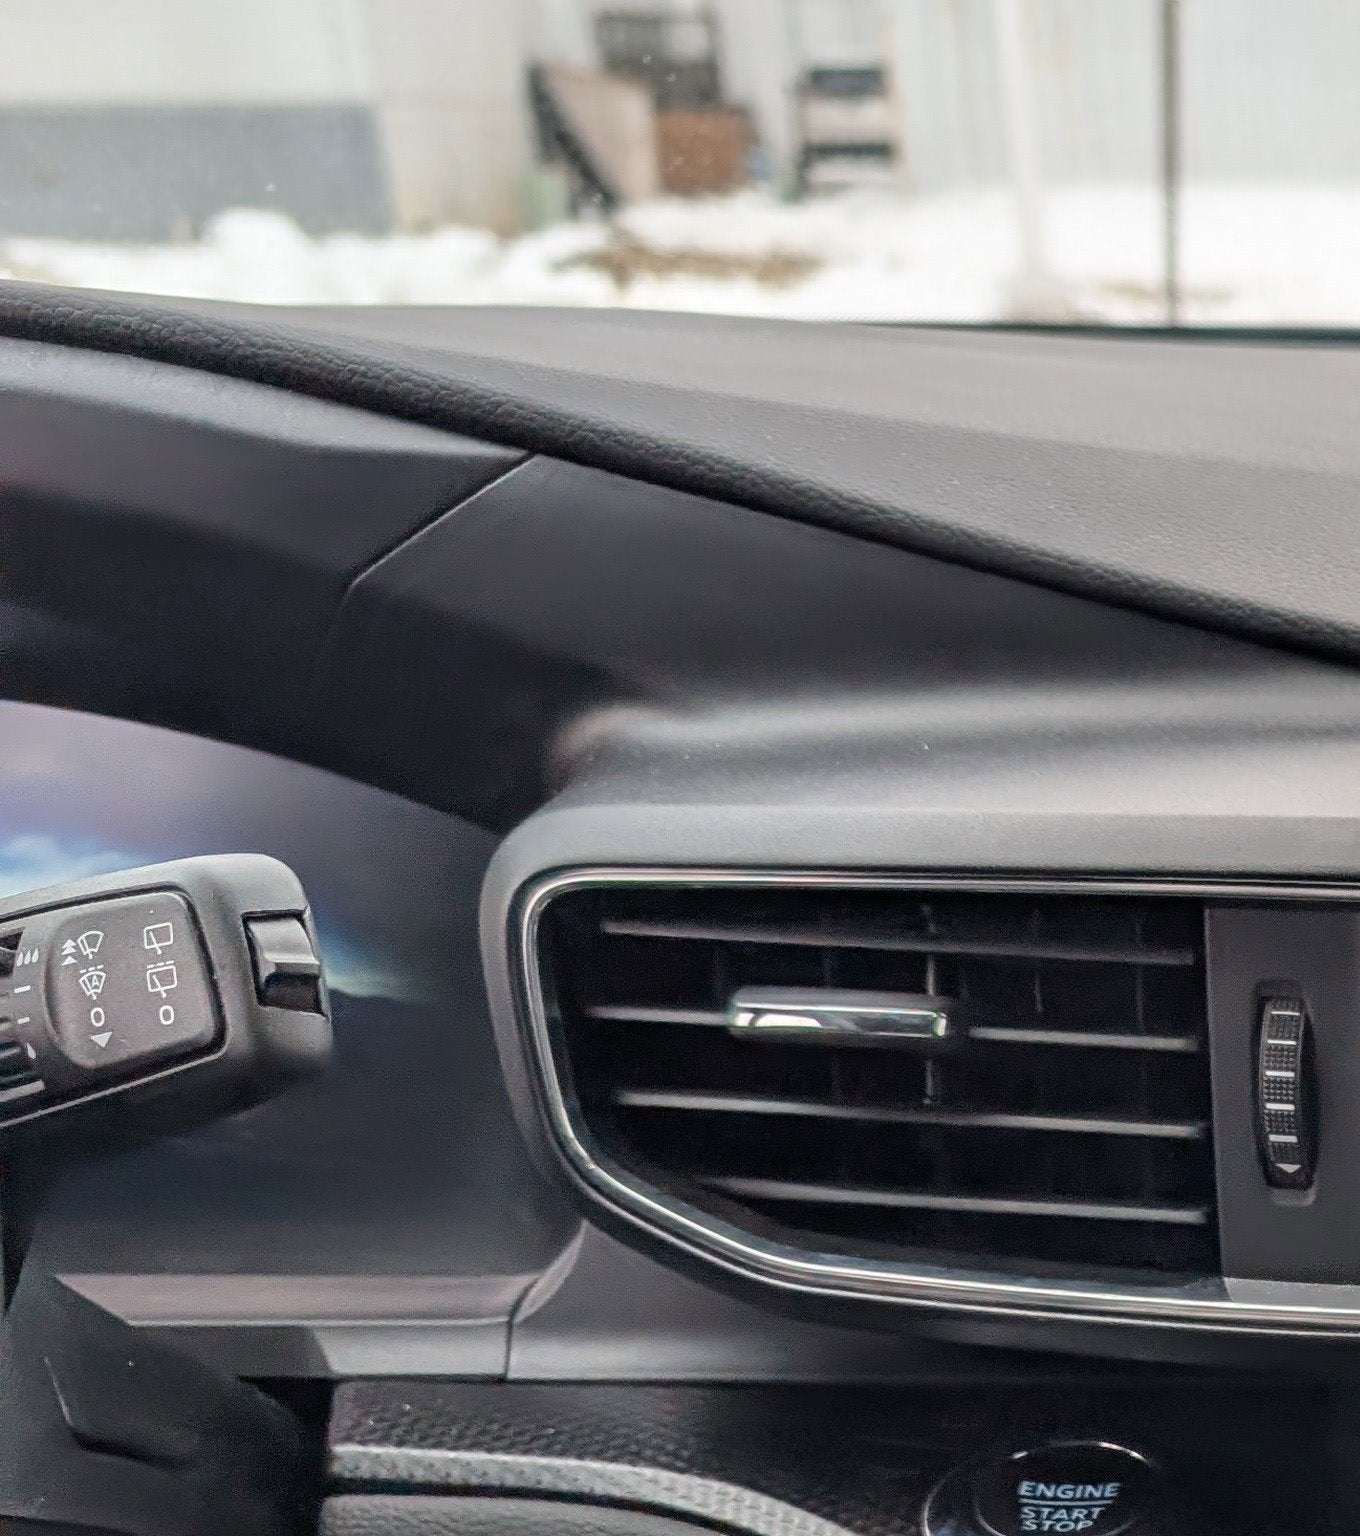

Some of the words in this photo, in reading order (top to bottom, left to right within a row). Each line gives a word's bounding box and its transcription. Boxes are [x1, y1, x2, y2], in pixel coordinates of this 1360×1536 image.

[1018, 1480, 1121, 1499] ENGINE
[1021, 1507, 1104, 1519] START
[1021, 1520, 1094, 1532] STOP
